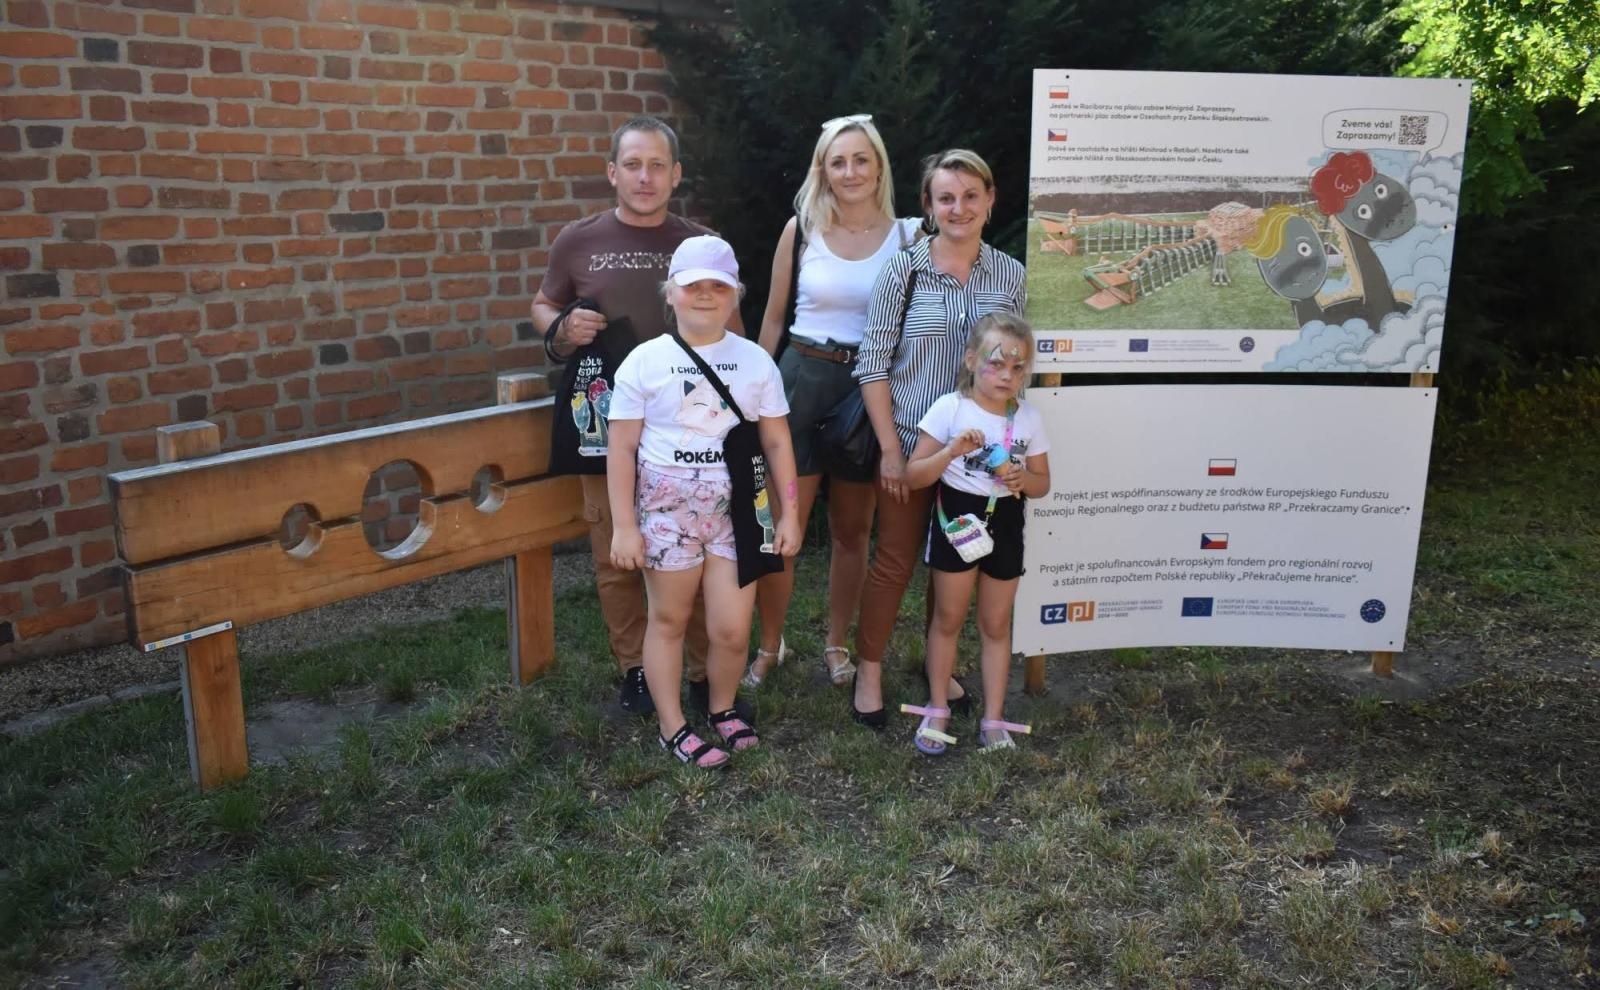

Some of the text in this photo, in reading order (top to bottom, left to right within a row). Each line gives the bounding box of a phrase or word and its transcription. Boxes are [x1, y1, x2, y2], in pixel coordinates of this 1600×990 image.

[1341, 119, 1393, 128] Zveme vás!
[1336, 130, 1396, 141] Zapraszamy!
[678, 365, 711, 375] CHOO
[716, 363, 738, 371] YOU!
[674, 448, 727, 464] POKÉM
[1053, 487, 1389, 503] Projekt jest współfinansowany ze środków Europejskiego Funduszu
[1033, 507, 1075, 518] Rozwoju
[1077, 504, 1145, 515] Regionalnego
[1146, 504, 1169, 512] oraz
[1178, 502, 1220, 512] budżetu
[1222, 502, 1265, 513] państwa
[1268, 502, 1282, 512] RP
[1283, 502, 1359, 515] „Przekraczamy
[1039, 556, 1373, 574] Projekt je spolufinancován Evropským fondem pro regionální rozvoj
[1052, 578, 1060, 587] a
[1061, 574, 1098, 586] státním
[1100, 572, 1153, 585] rozpočtem
[1155, 570, 1187, 581] Polské
[1189, 570, 1236, 583] republiky
